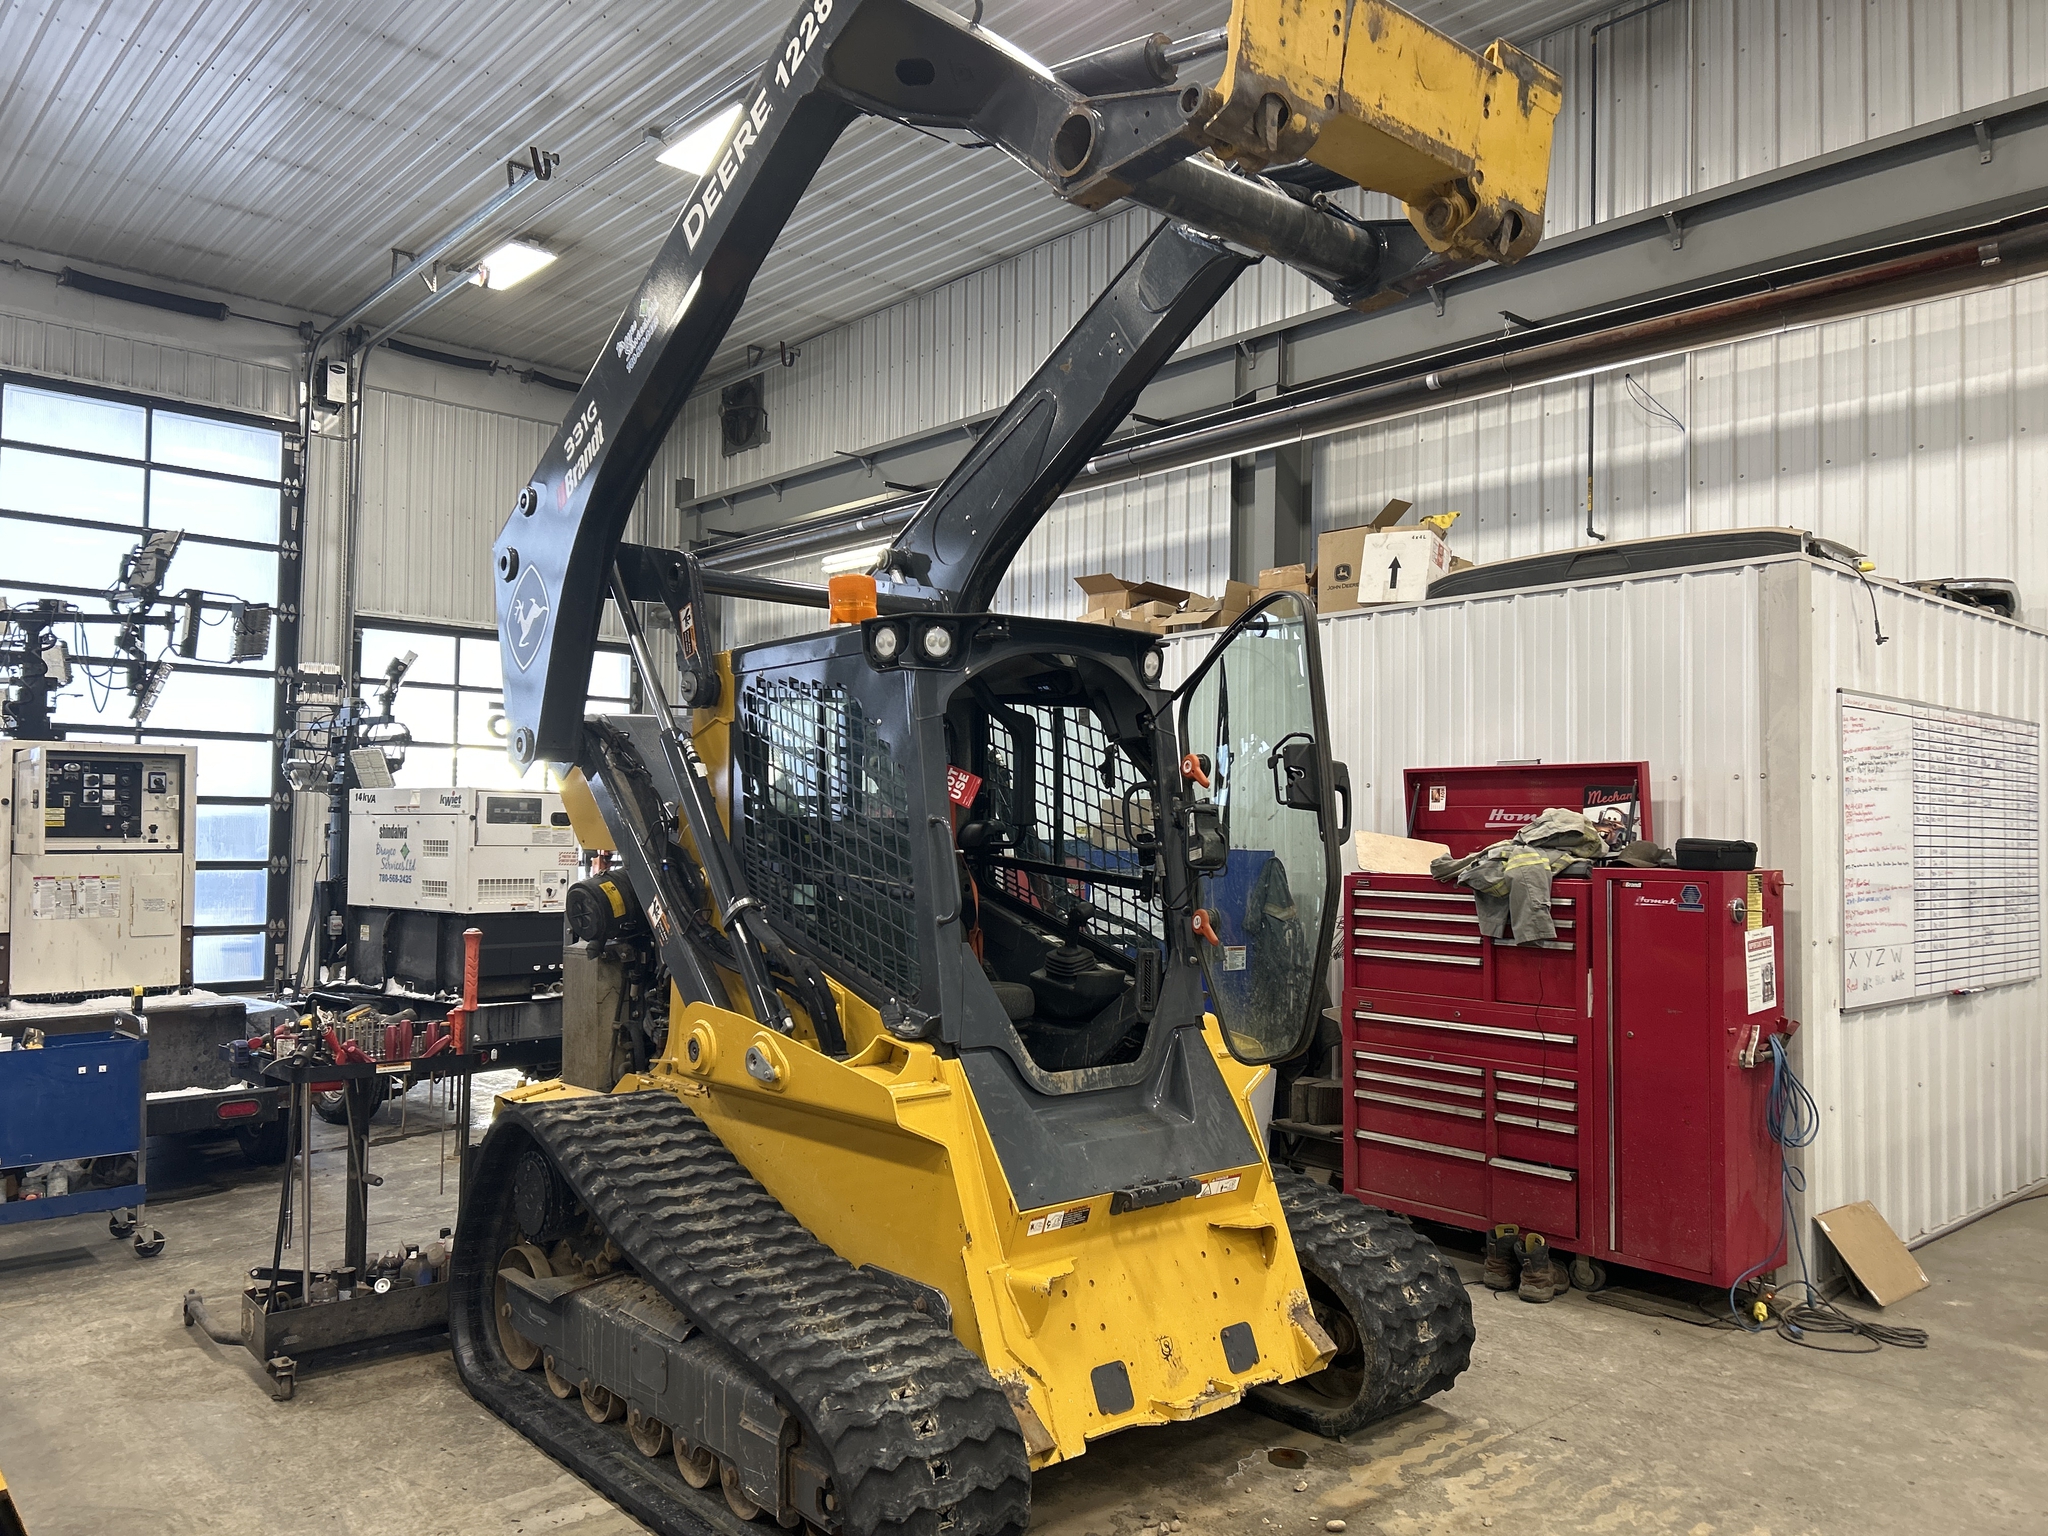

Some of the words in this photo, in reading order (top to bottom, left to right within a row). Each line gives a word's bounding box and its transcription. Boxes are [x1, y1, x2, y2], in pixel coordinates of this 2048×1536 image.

[682, 88, 767, 250] DEERE
[774, 0, 833, 88] 1228
[563, 400, 598, 461] 331G
[564, 419, 605, 499] Brandt
[947, 767, 958, 791] OT
[950, 772, 970, 800] USE
[355, 792, 376, 804] 14kVA
[1587, 789, 1633, 805] Mechan
[1488, 808, 1537, 822] Hom
[379, 823, 408, 839] shindaiwa
[1849, 951, 1857, 969] X
[1865, 950, 1872, 968] Y
[1876, 948, 1885, 967] Z
[1891, 947, 1902, 963] W
[1846, 978, 1858, 993] Red
